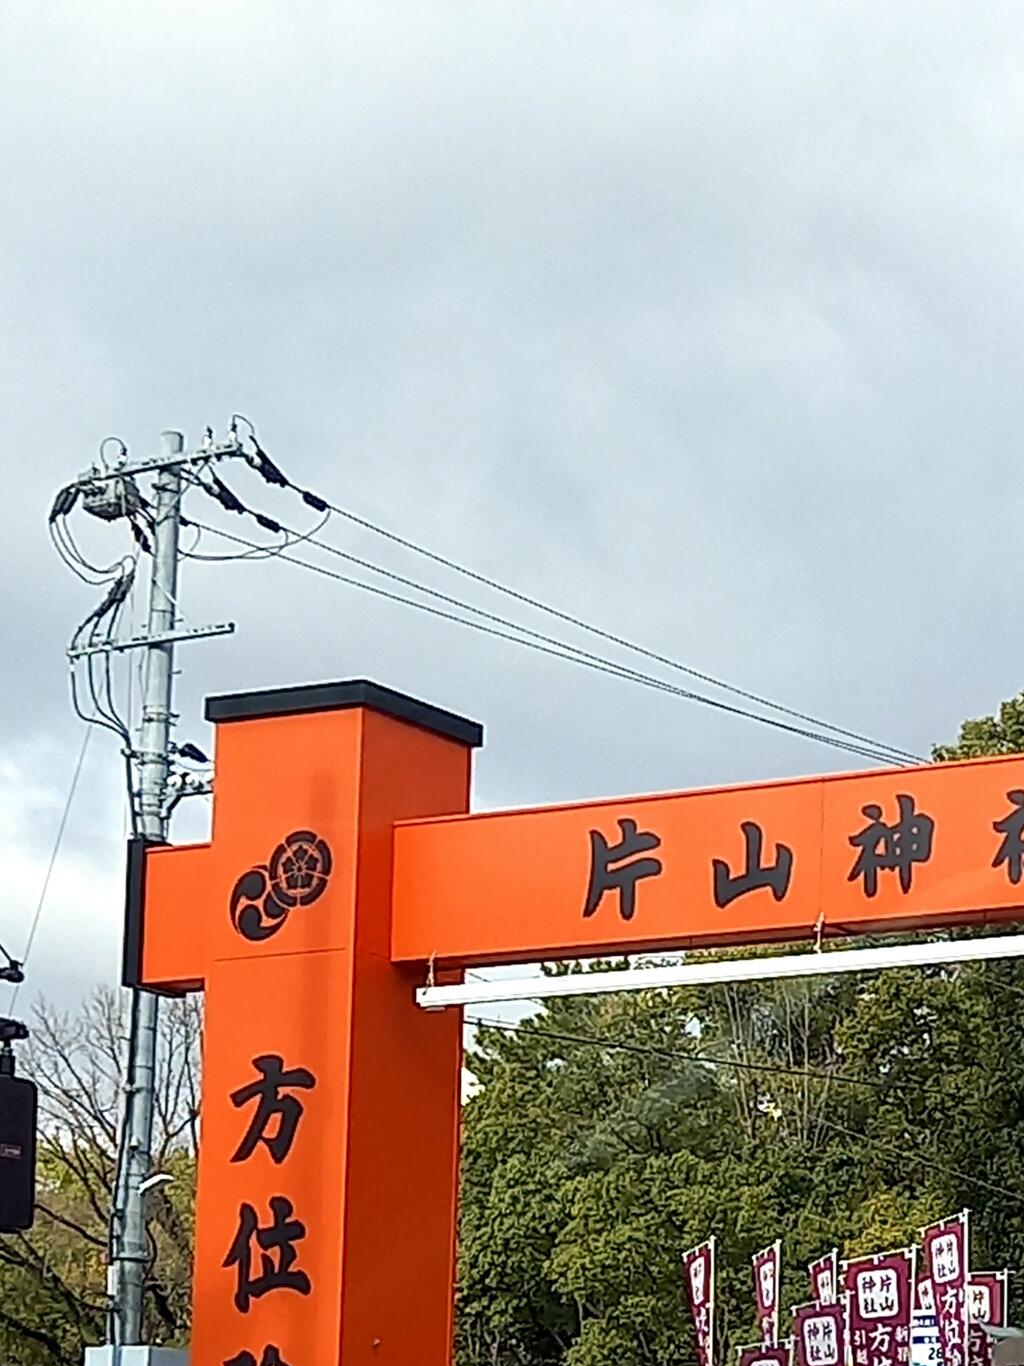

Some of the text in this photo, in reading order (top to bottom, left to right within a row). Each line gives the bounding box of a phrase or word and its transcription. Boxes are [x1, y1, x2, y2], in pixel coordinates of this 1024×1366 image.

[862, 1275, 878, 1314] 神社
[880, 1273, 895, 1312] 片山
[807, 1321, 823, 1362] 神社
[822, 1320, 837, 1359] 片山
